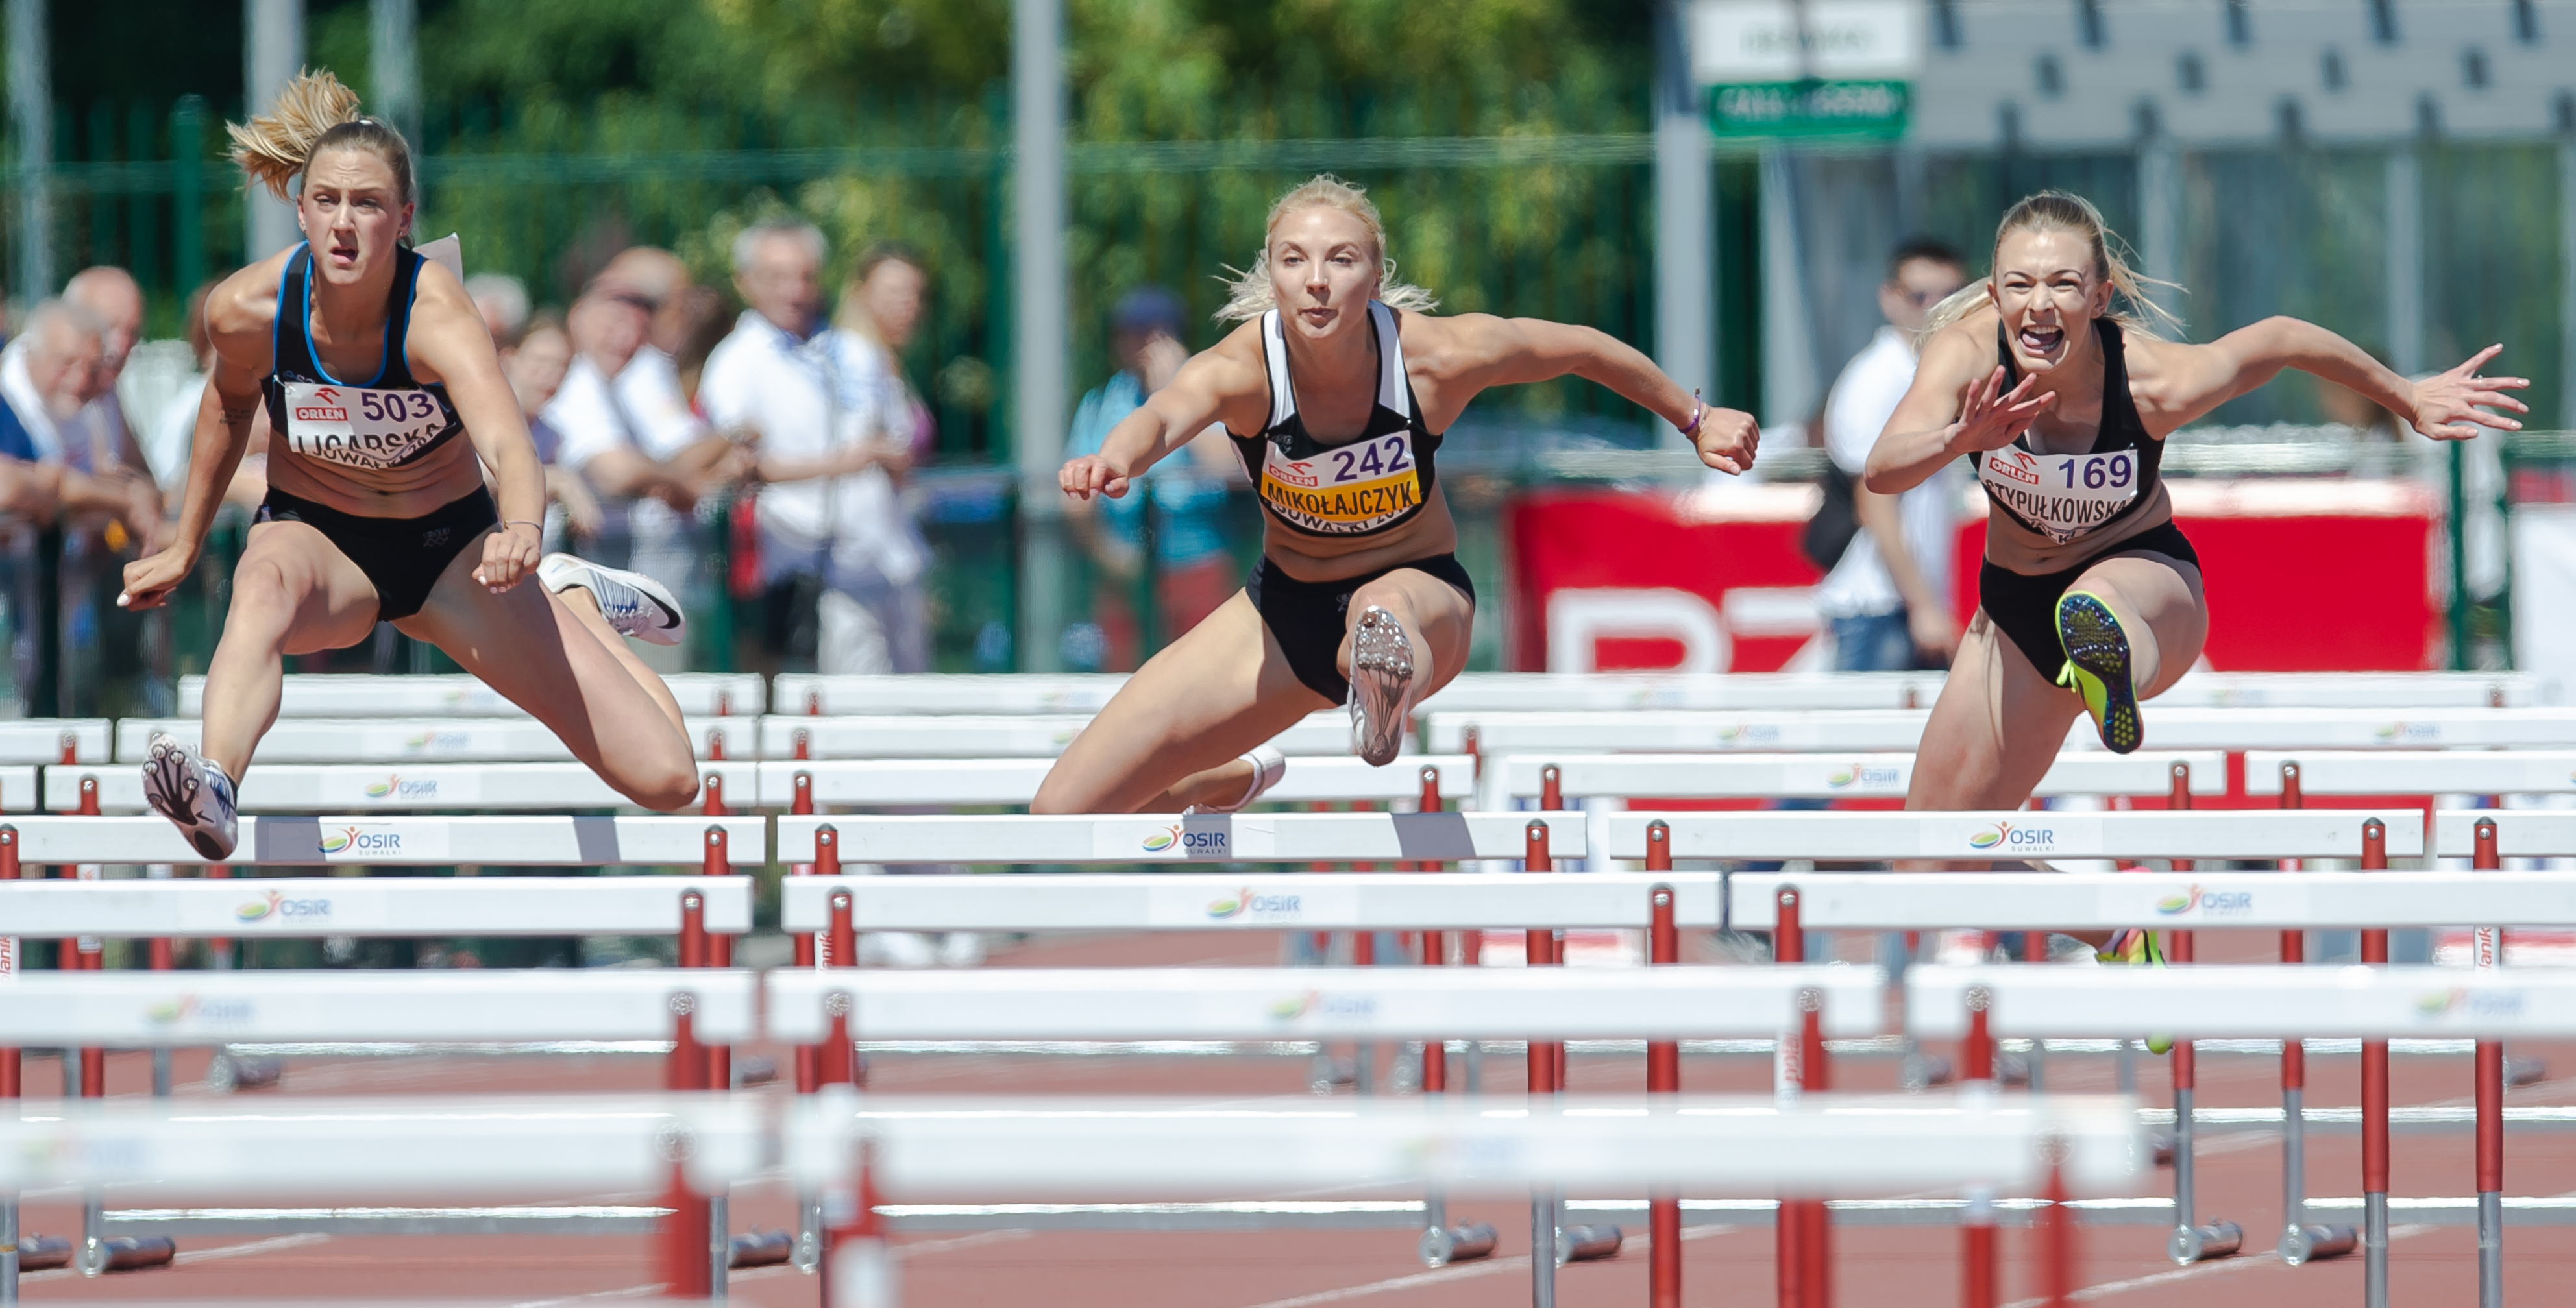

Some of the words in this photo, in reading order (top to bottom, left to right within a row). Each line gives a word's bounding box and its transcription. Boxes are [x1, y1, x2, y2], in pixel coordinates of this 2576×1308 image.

[298, 408, 345, 420] ORLEN
[361, 391, 434, 422] 503
[1332, 436, 1410, 482] 242
[1270, 468, 1316, 486] ORLEN
[1991, 459, 2037, 484] ORLEN
[2059, 455, 2132, 489] 169
[1267, 480, 1414, 516] MIKOŁAJCZYK
[358, 834, 400, 848] OSIR
[1183, 832, 1226, 847] OSIR
[2010, 829, 2054, 844] OSIR
[280, 899, 332, 916] OSIR
[1251, 895, 1301, 912] OSIR
[2202, 891, 2252, 909] OSIR
